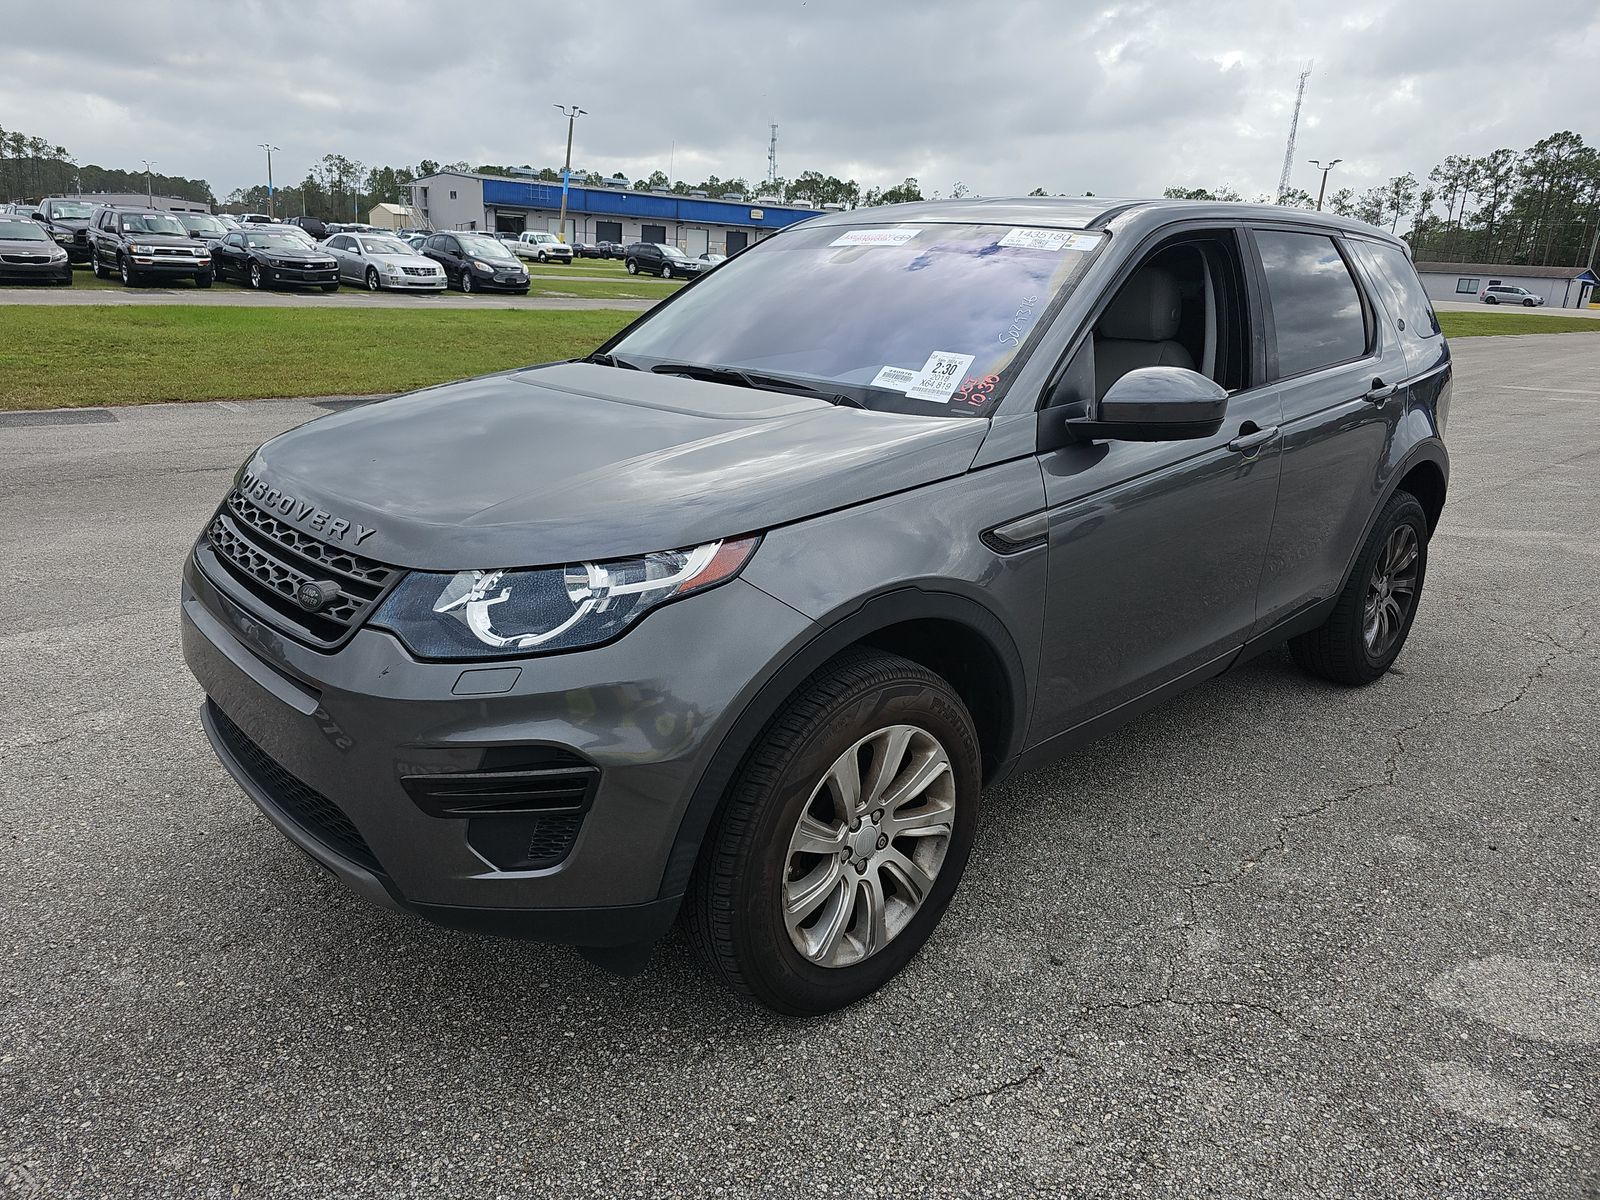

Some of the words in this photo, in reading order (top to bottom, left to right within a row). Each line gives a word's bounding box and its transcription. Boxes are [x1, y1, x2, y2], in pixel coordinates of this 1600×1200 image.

[1018, 229, 1072, 241] 1435180
[931, 362, 958, 376] 2:30
[930, 373, 950, 382] 2018
[242, 471, 377, 546] DISCOVERY
